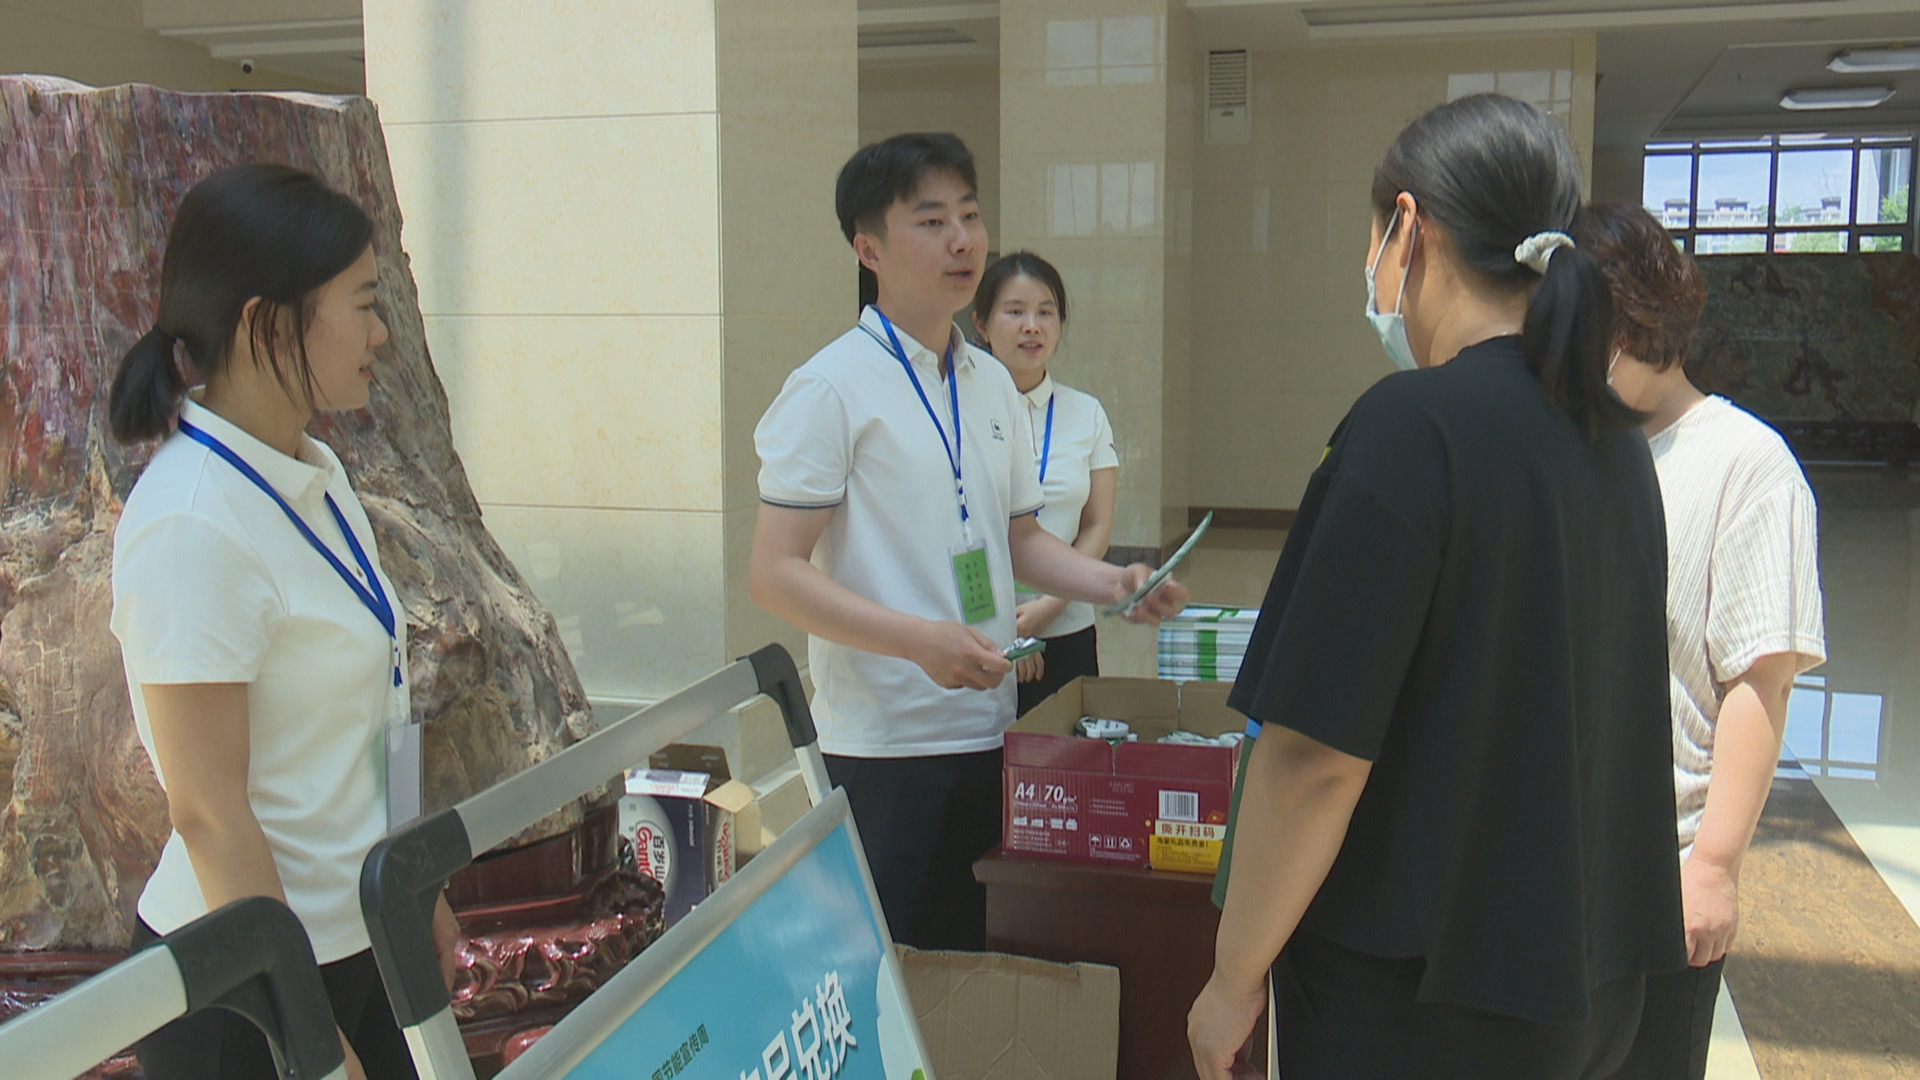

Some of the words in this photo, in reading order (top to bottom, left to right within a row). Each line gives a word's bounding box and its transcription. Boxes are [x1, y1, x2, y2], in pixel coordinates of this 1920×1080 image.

[1015, 782, 1035, 800] A4
[1161, 823, 1215, 838] 撕开扫码
[653, 835, 665, 879] 百岁山
[740, 969, 857, 1080] 兑换
